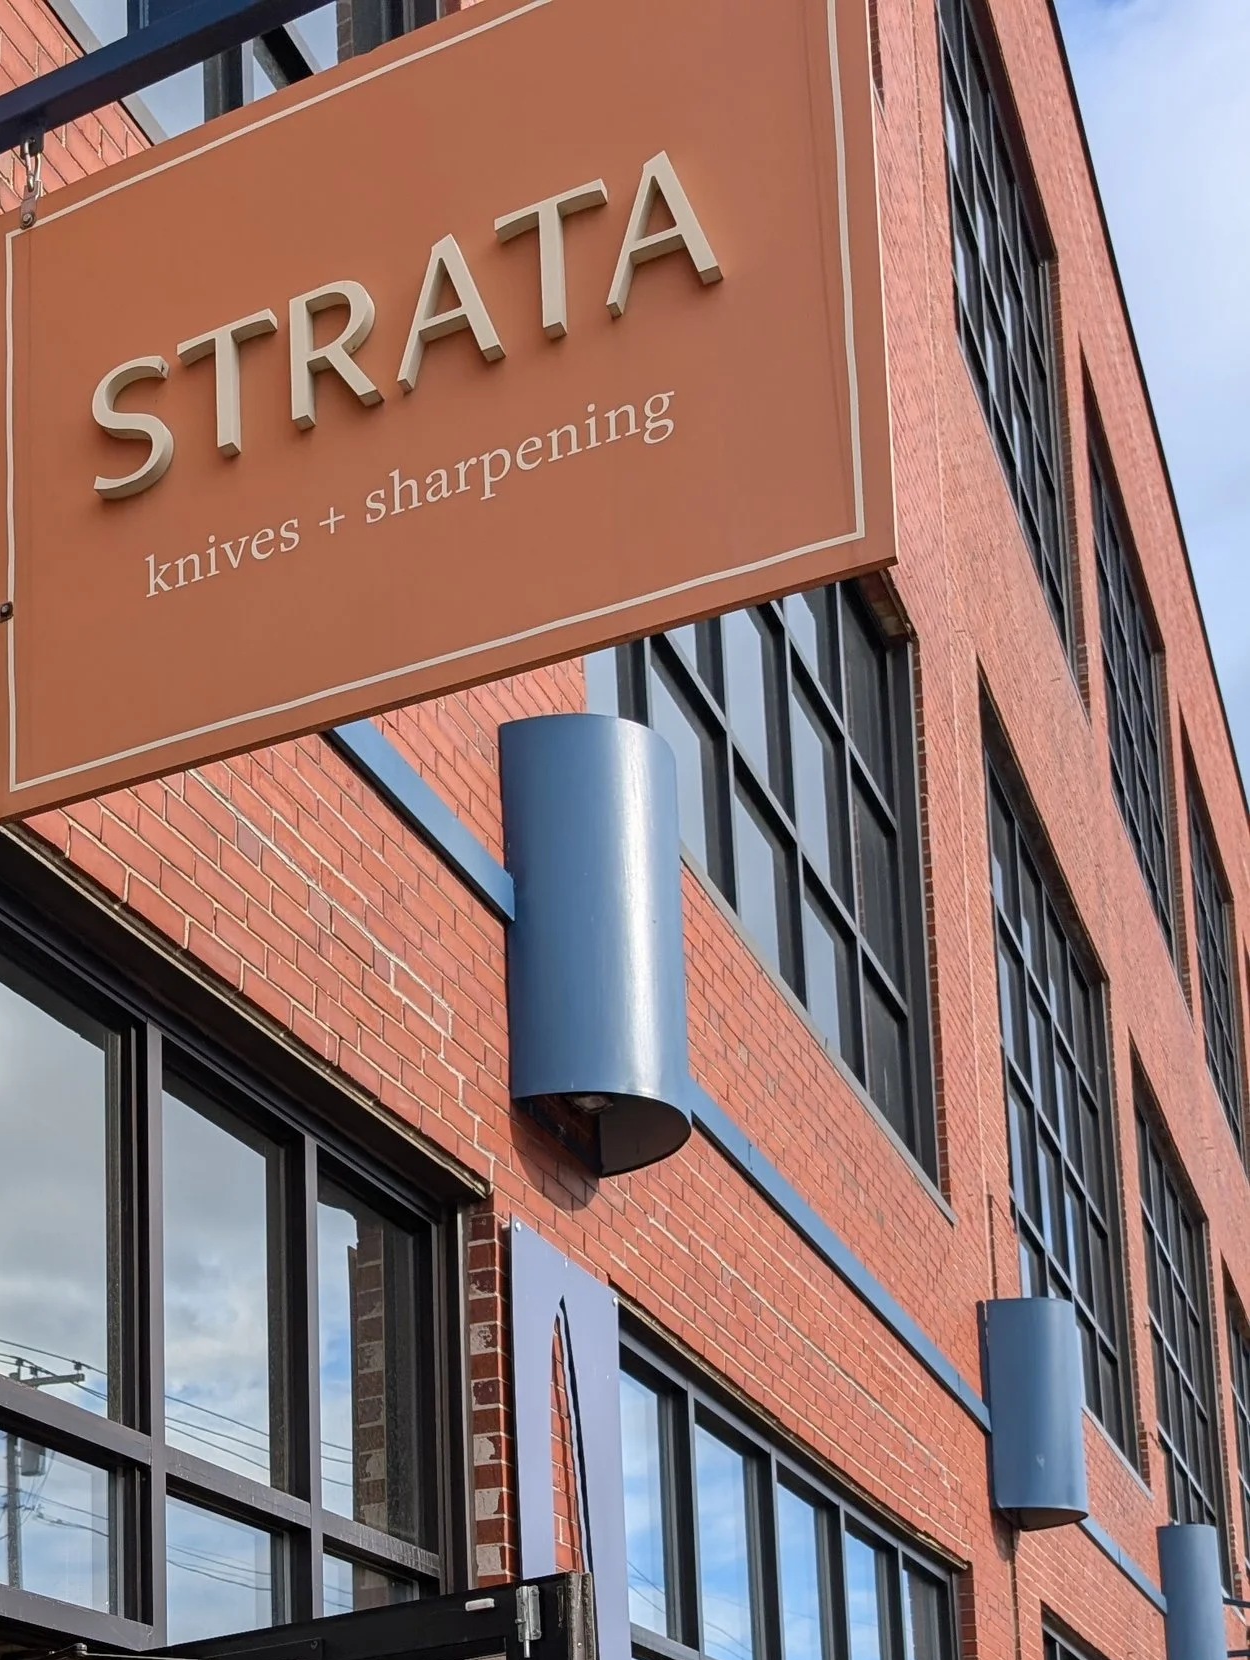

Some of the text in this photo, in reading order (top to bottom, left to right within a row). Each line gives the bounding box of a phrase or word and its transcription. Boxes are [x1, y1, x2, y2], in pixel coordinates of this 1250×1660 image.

[91, 151, 724, 501] STRATA
[144, 390, 676, 598] knives + sharpening
